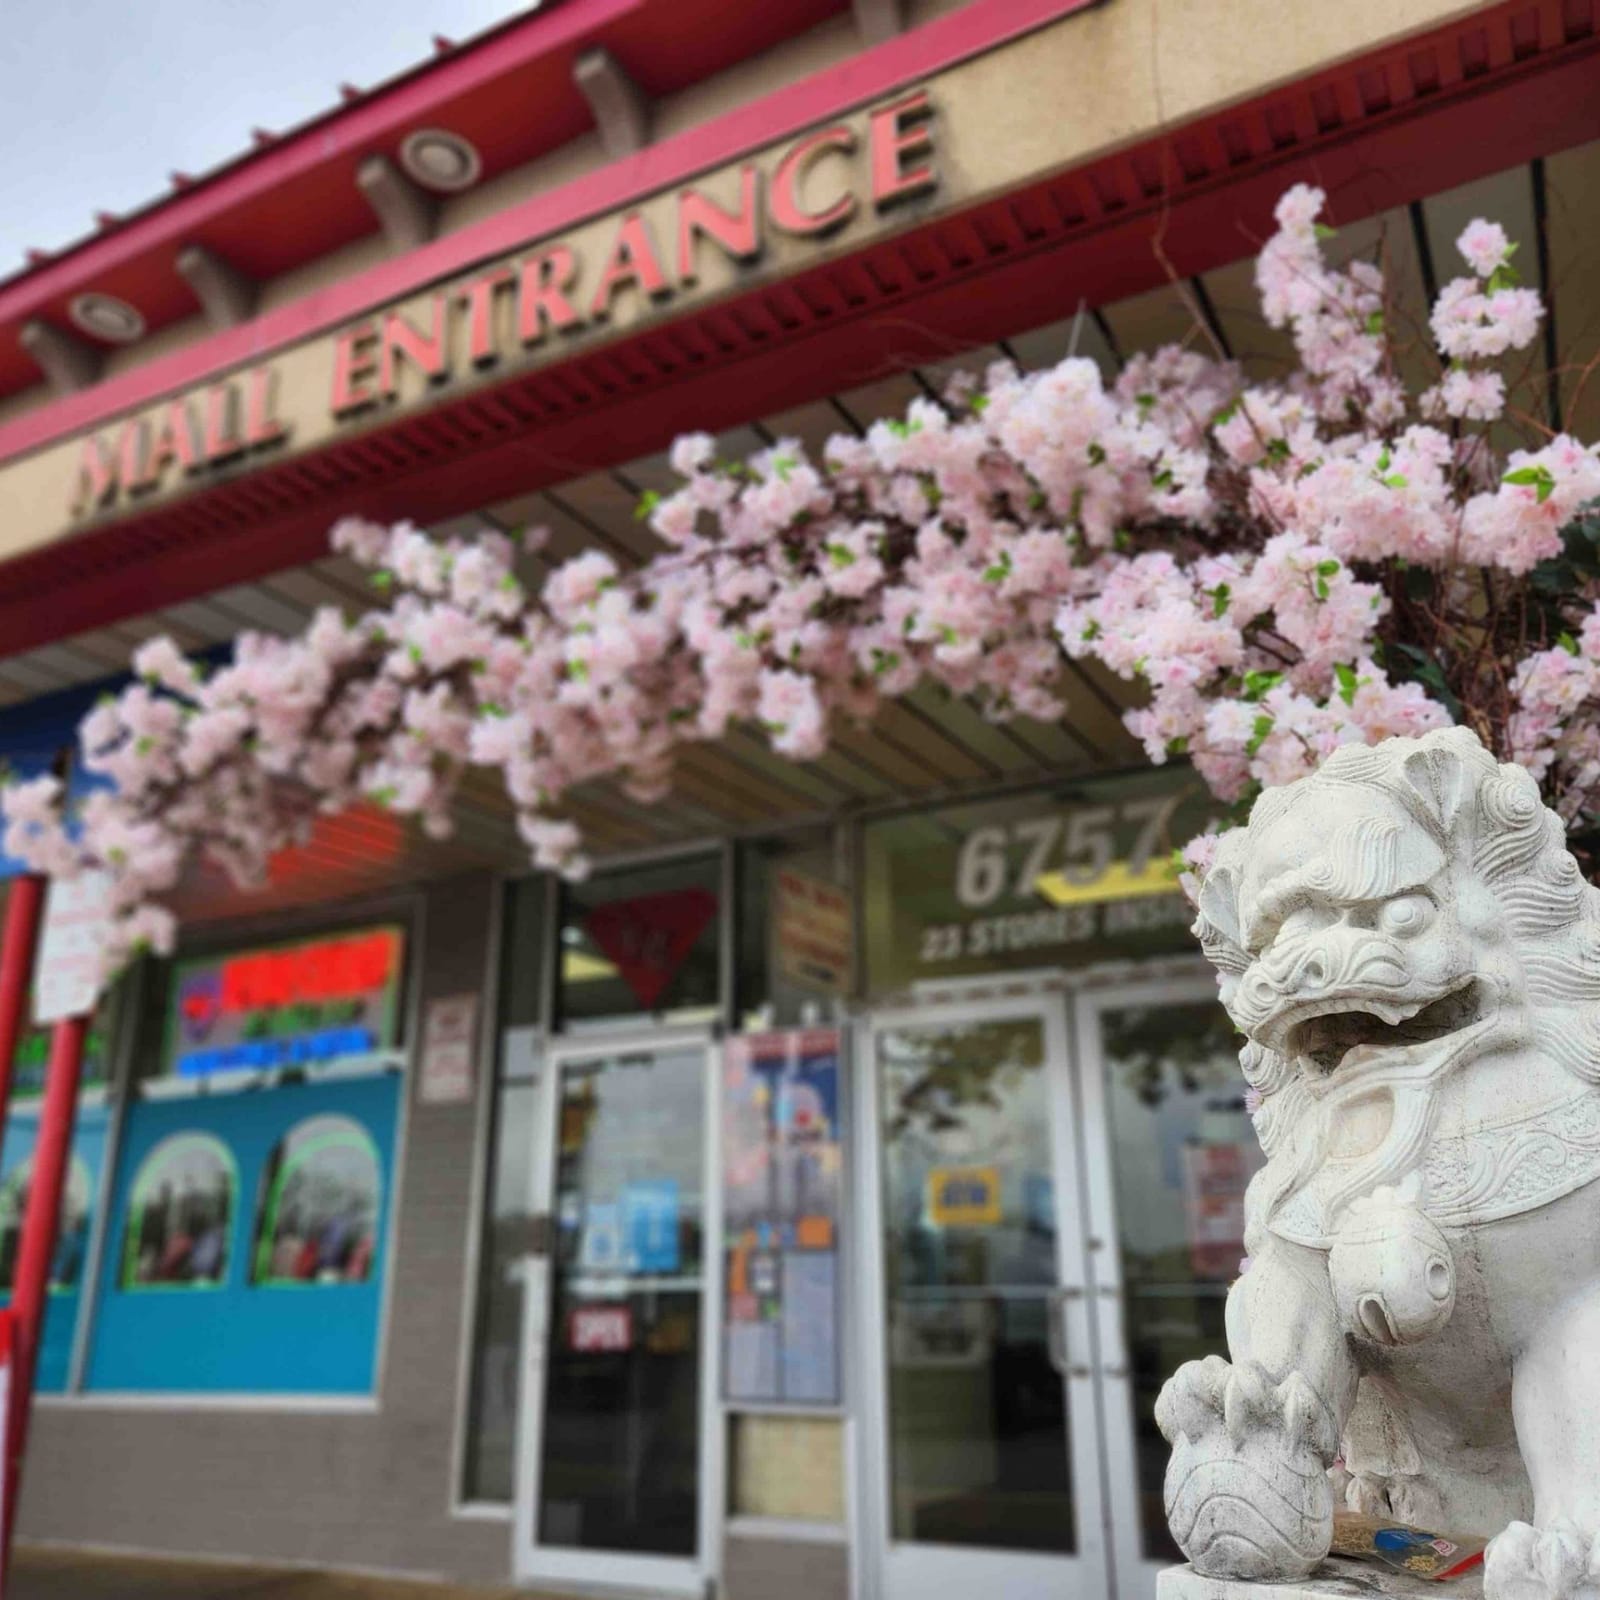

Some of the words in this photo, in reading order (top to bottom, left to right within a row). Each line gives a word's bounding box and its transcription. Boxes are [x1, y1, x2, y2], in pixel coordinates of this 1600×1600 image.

[69, 368, 286, 514] MALL
[330, 92, 934, 412] ENTRANCE
[955, 798, 1178, 908] 6757
[919, 924, 963, 961] 23
[968, 903, 1097, 957] STORES
